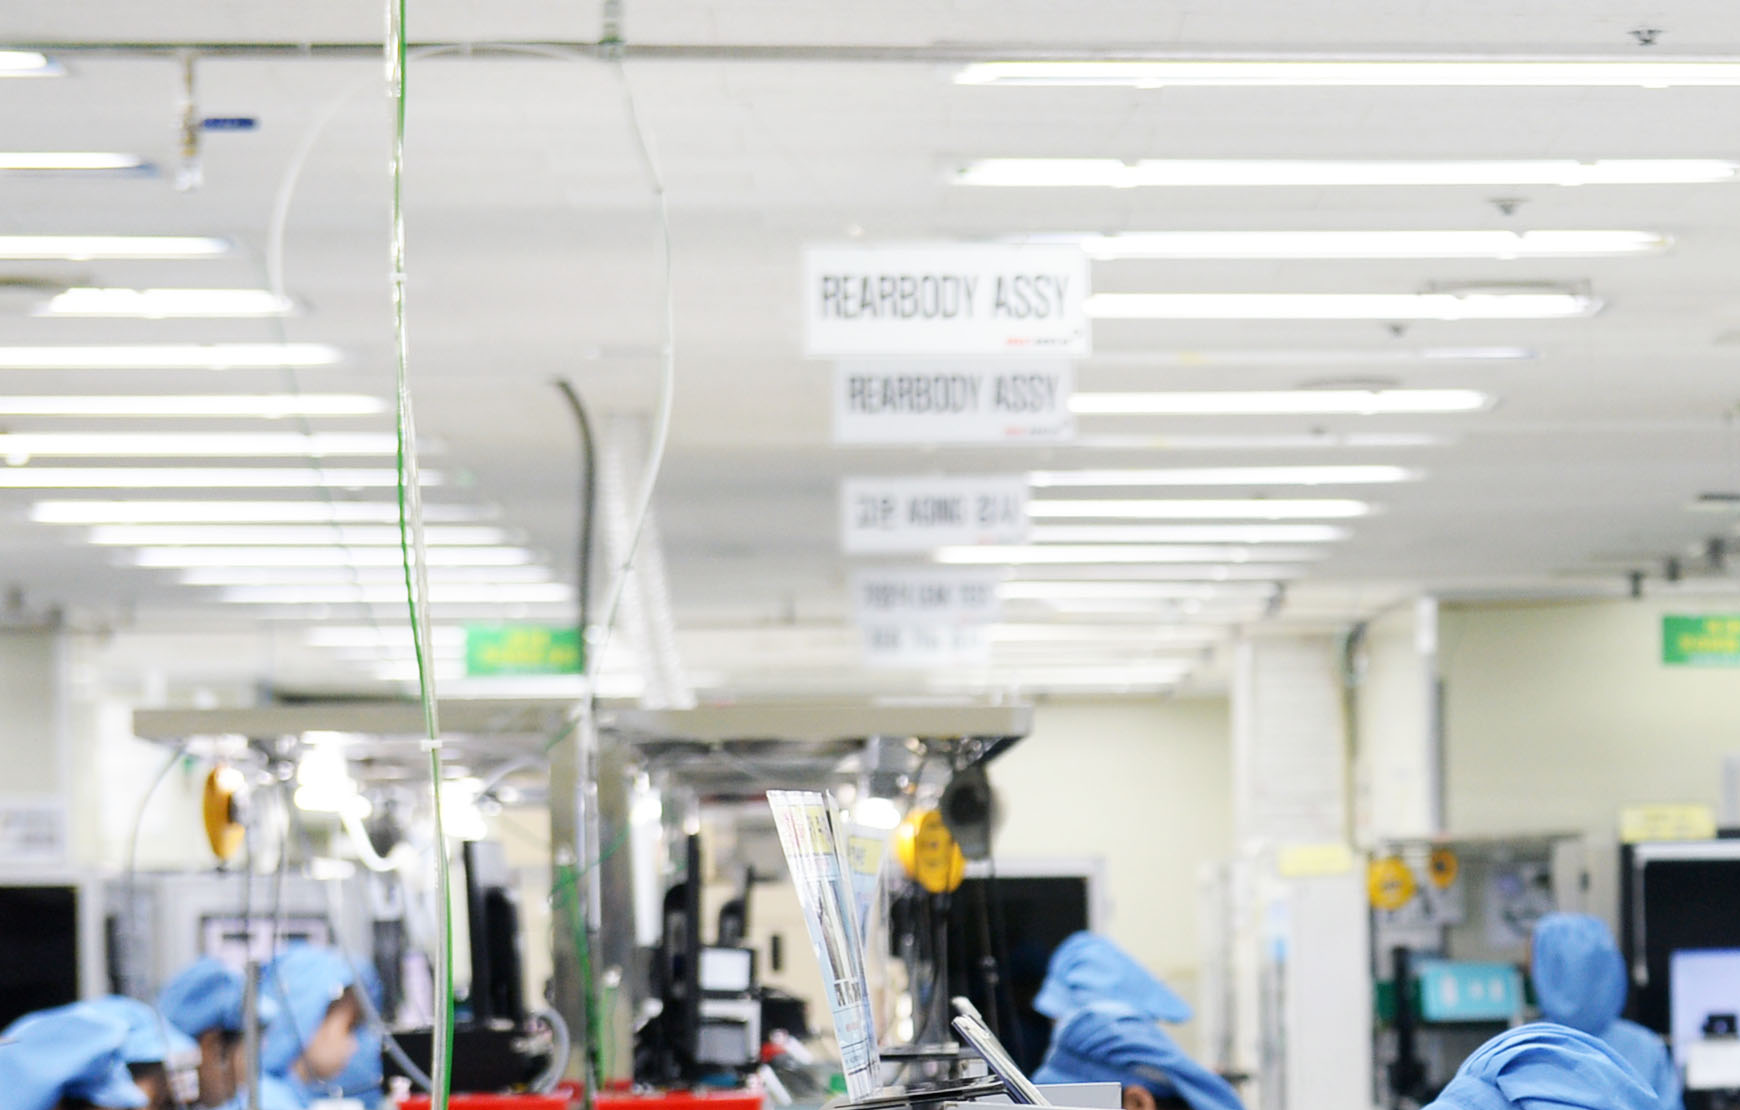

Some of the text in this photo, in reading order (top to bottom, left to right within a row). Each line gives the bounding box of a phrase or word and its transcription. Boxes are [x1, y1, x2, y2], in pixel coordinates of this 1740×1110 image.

[820, 274, 1069, 319] REARBODY ASSY
[847, 374, 1062, 414] REARBODY ASSY
